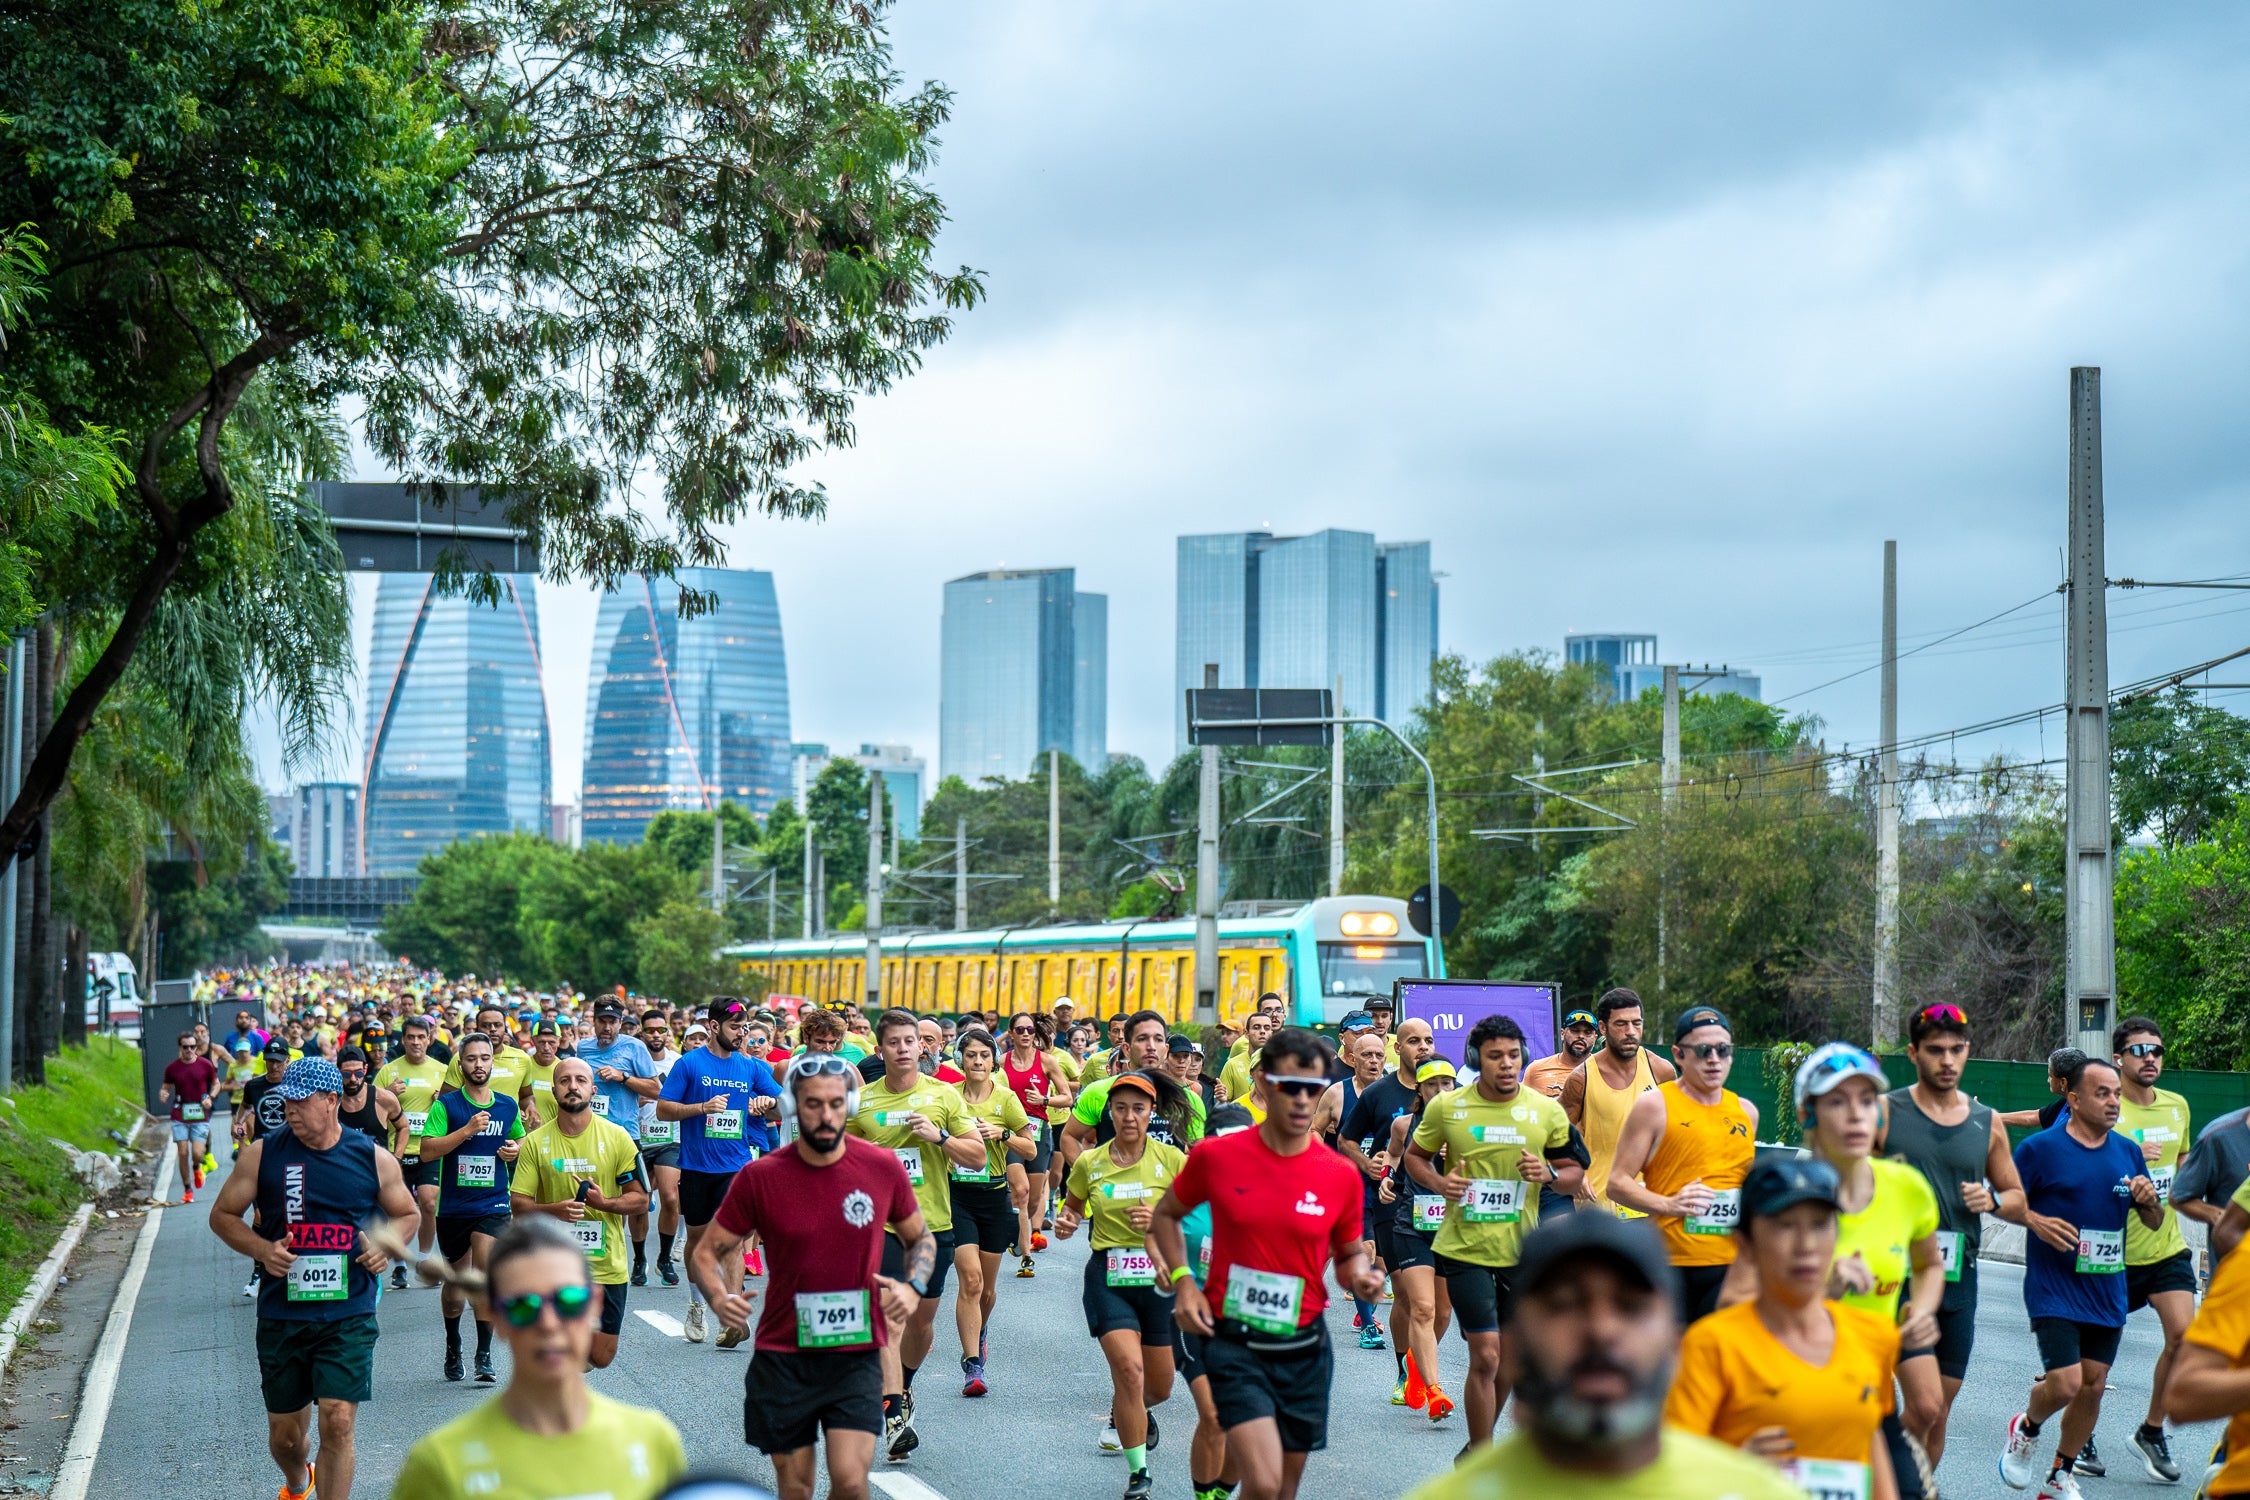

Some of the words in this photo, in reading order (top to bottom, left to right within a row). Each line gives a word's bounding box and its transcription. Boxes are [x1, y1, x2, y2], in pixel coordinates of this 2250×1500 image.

[1433, 1013, 1463, 1030] nu
[713, 1078, 748, 1089] QITECH
[650, 1125, 669, 1134] 8692
[717, 1118, 738, 1128] 8709
[469, 1165, 492, 1175] 7057
[2151, 1178, 2171, 1190] 341
[286, 1165, 303, 1224] TRAIN
[1481, 1193, 1511, 1205] 7418
[289, 1226, 351, 1247] HARD
[1122, 1257, 1153, 1270] 7559
[302, 1269, 337, 1282] 6012
[1246, 1288, 1290, 1310] 8046
[818, 1307, 856, 1325] 7691
